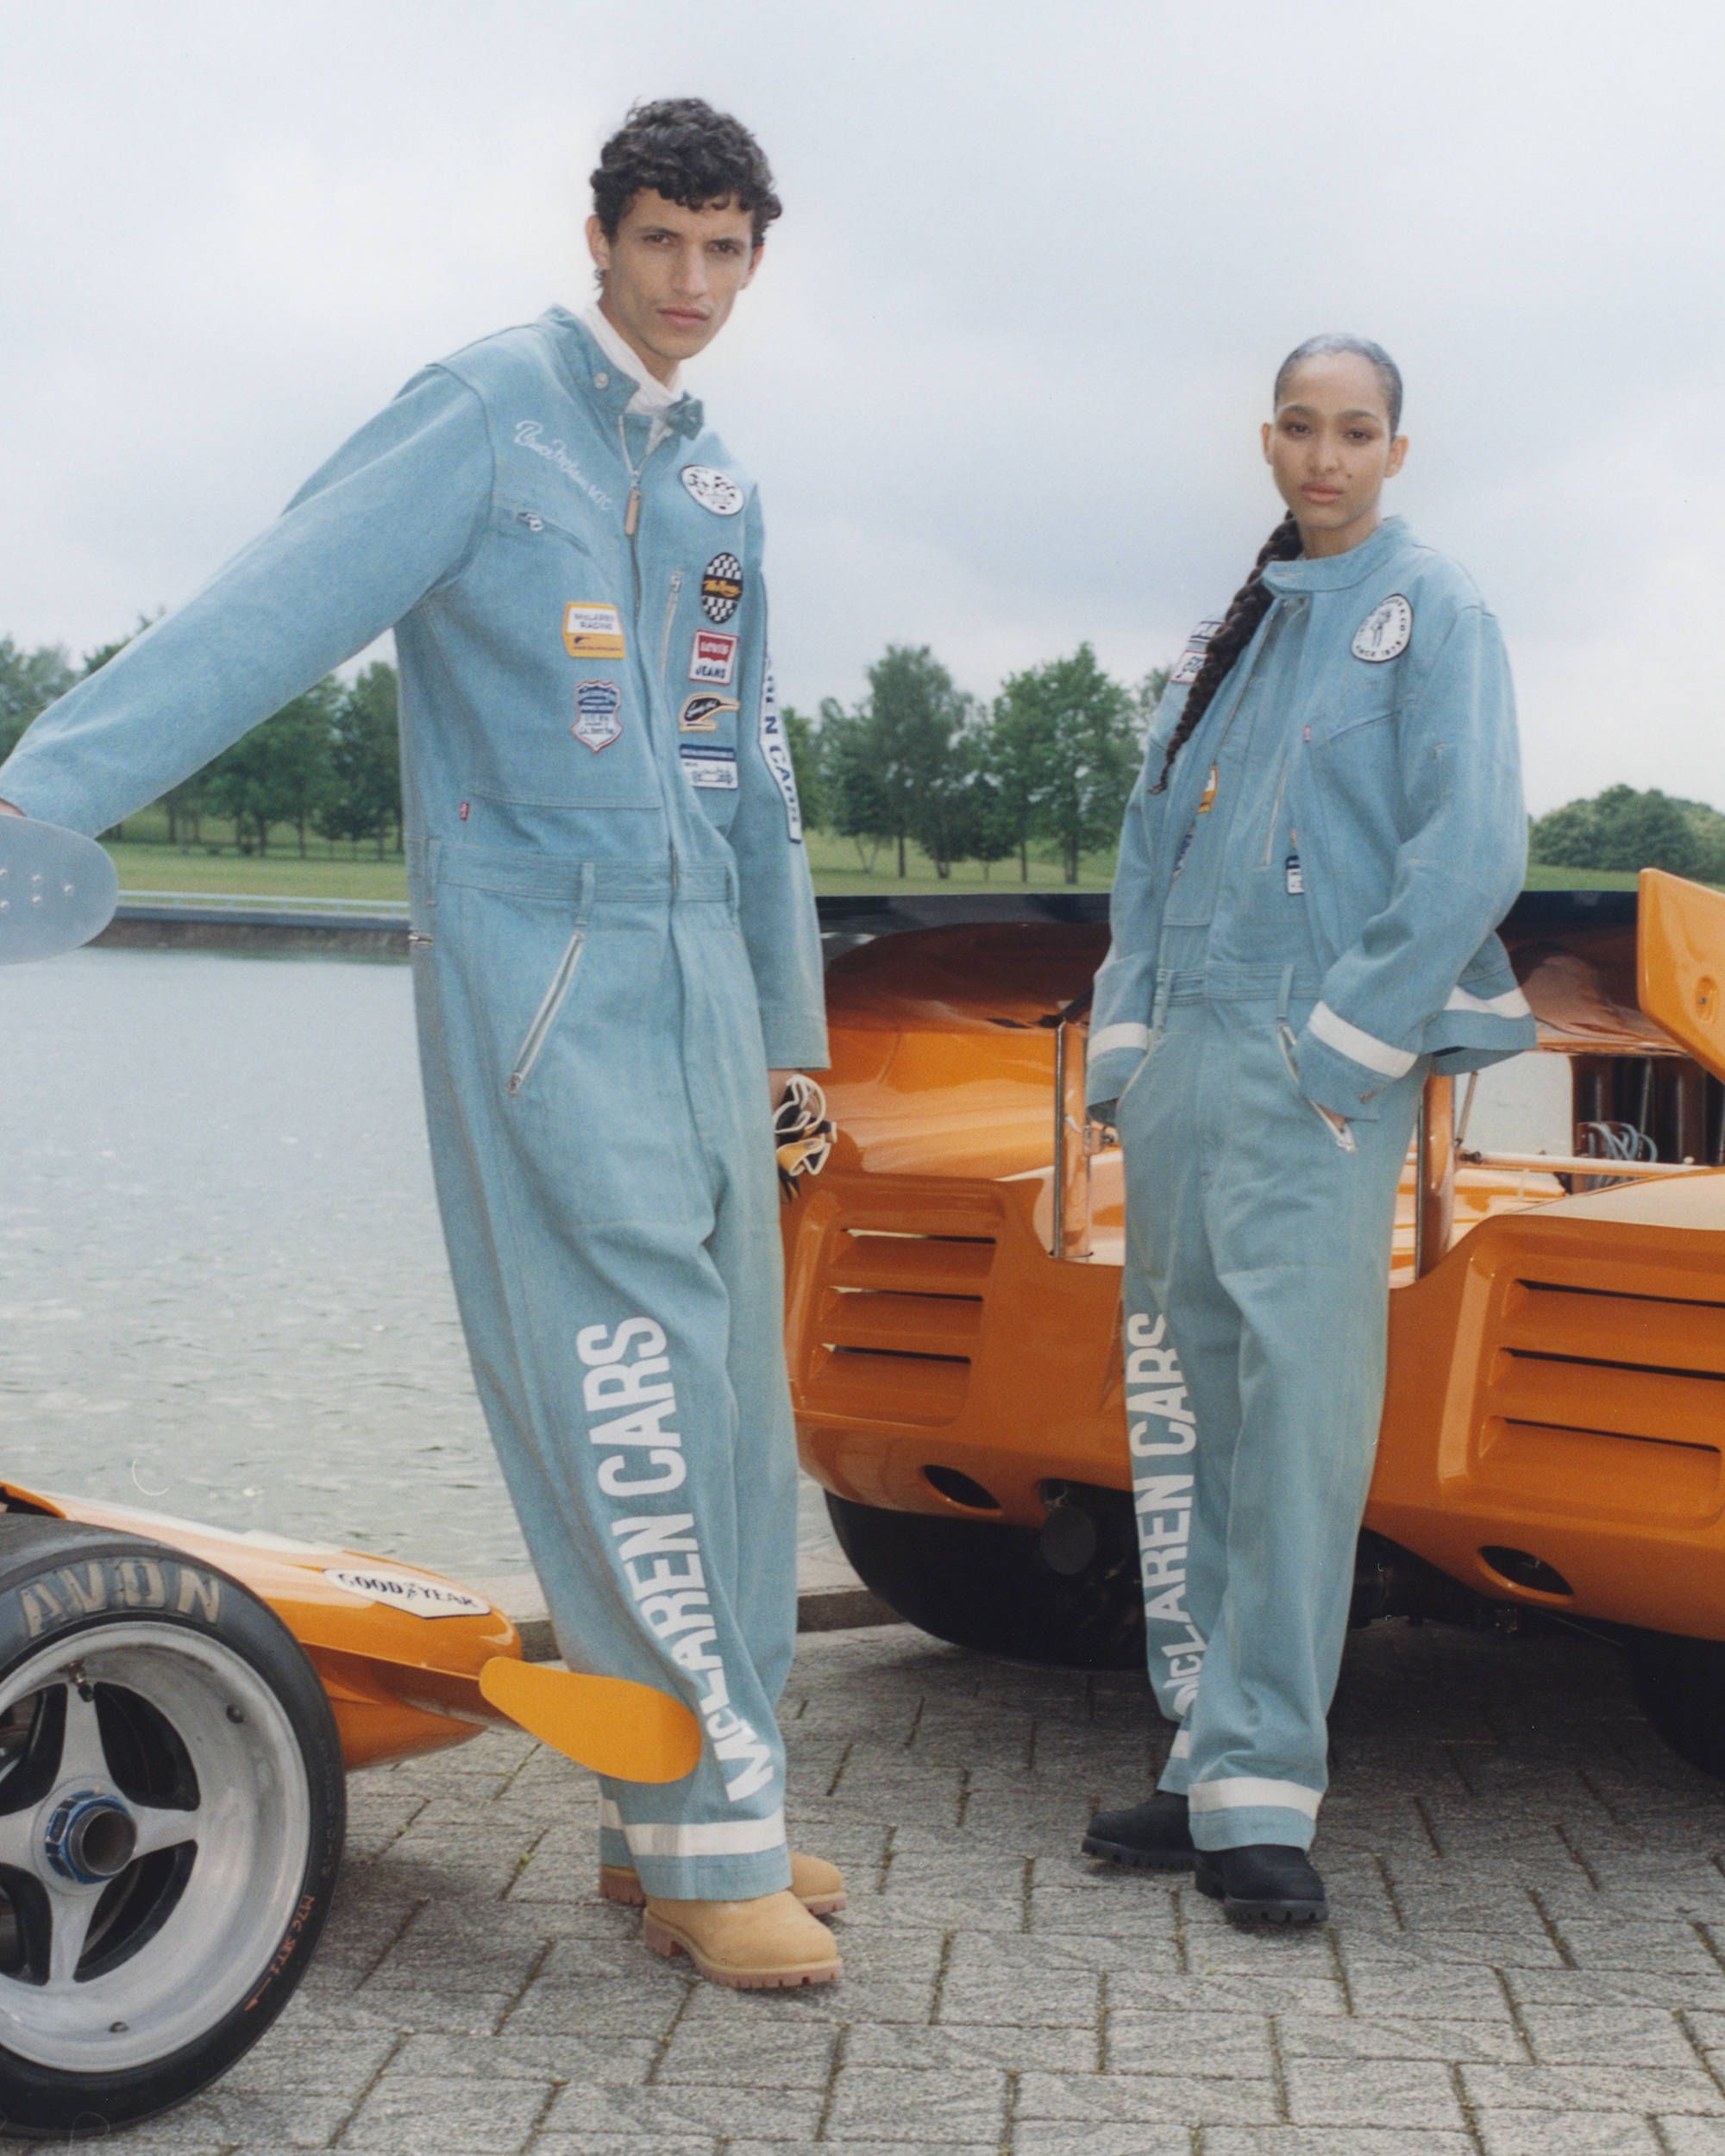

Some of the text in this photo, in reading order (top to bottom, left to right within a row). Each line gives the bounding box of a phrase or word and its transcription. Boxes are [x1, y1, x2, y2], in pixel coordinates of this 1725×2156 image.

[575, 1316, 687, 1498] CARS
[1126, 1312, 1197, 1457] CARS
[20, 1556, 221, 1637] AVON
